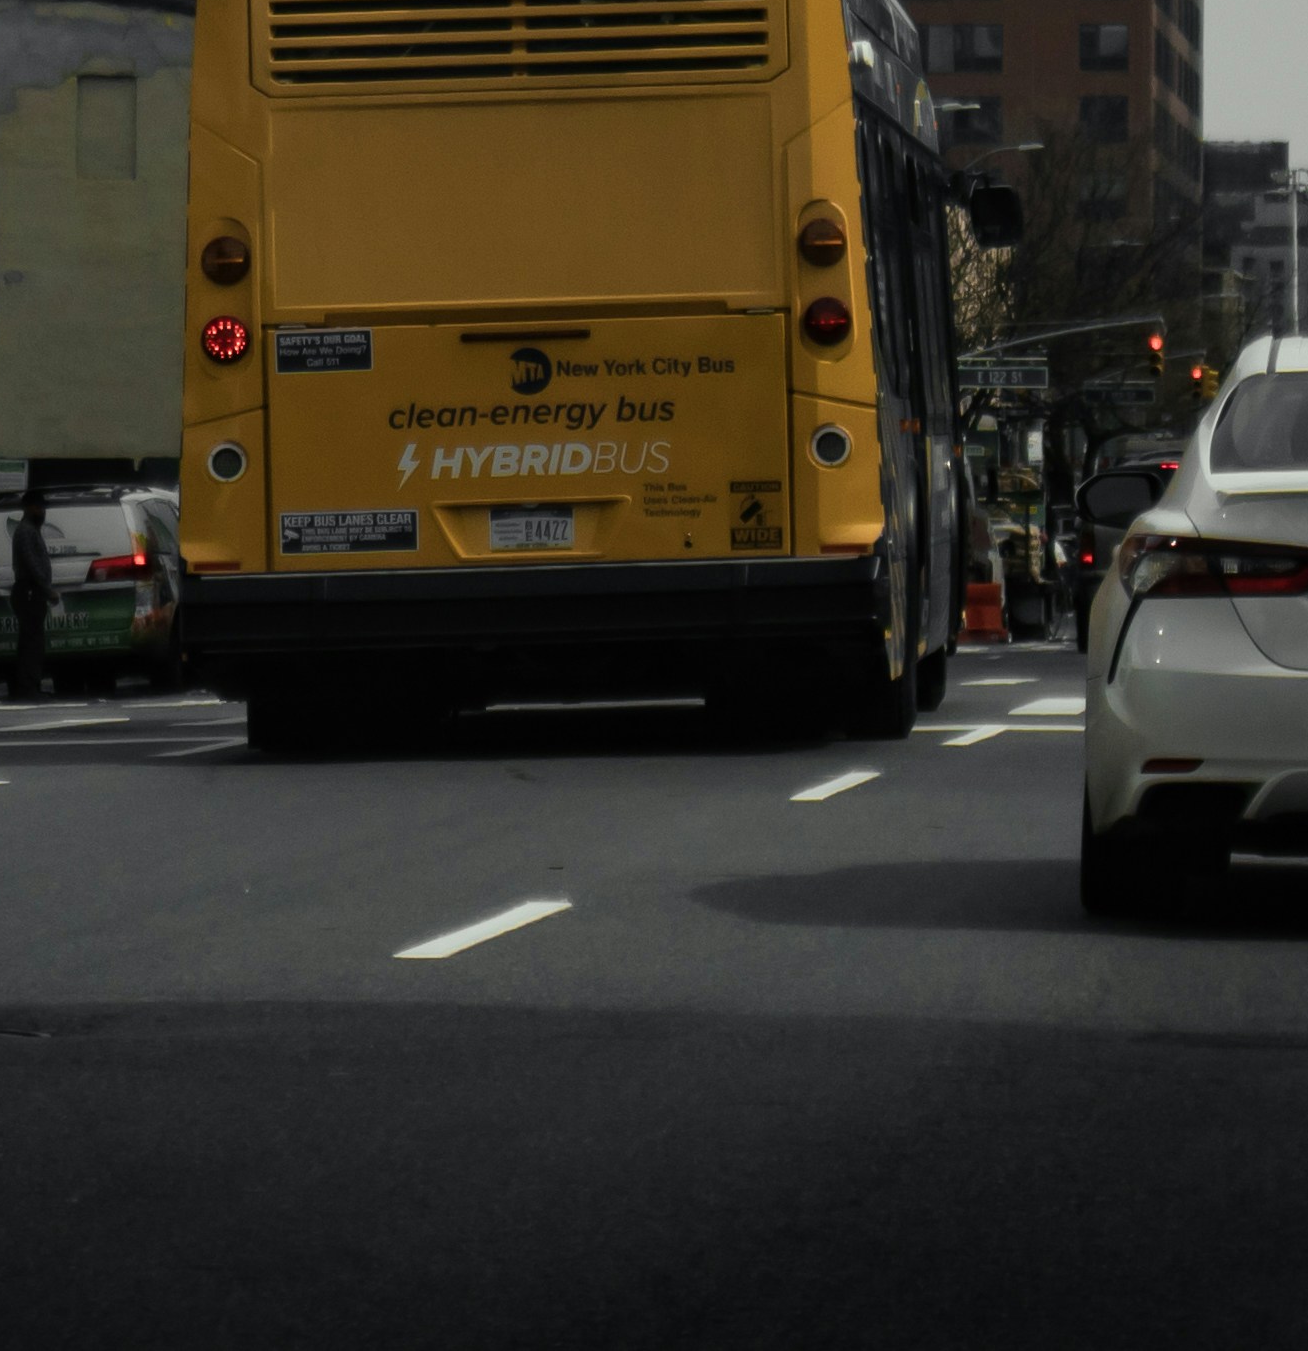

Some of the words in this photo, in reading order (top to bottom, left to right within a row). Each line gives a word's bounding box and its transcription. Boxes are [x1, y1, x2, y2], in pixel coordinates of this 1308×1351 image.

[279, 336, 321, 346] SAFETY'S
[323, 335, 341, 344] OUR
[344, 334, 367, 344] GOAL
[302, 347, 317, 355] Are
[319, 347, 333, 355] We
[306, 358, 323, 367] Call
[556, 360, 598, 377] New
[603, 359, 645, 376] York
[652, 357, 691, 377] City
[698, 357, 735, 373] Bus
[977, 371, 985, 384] E
[389, 402, 606, 430] clean-energy
[616, 396, 675, 422] bus
[430, 441, 672, 479] HYBRIDBUS
[643, 483, 664, 492] This
[668, 482, 687, 491] Bus
[732, 482, 779, 492] CAUTION
[284, 516, 311, 528] KEEP
[314, 515, 336, 527] BUS
[339, 514, 374, 526] LANES
[376, 513, 411, 525] CLEAR
[535, 520, 568, 540] 4422
[733, 529, 779, 542] WIDE
